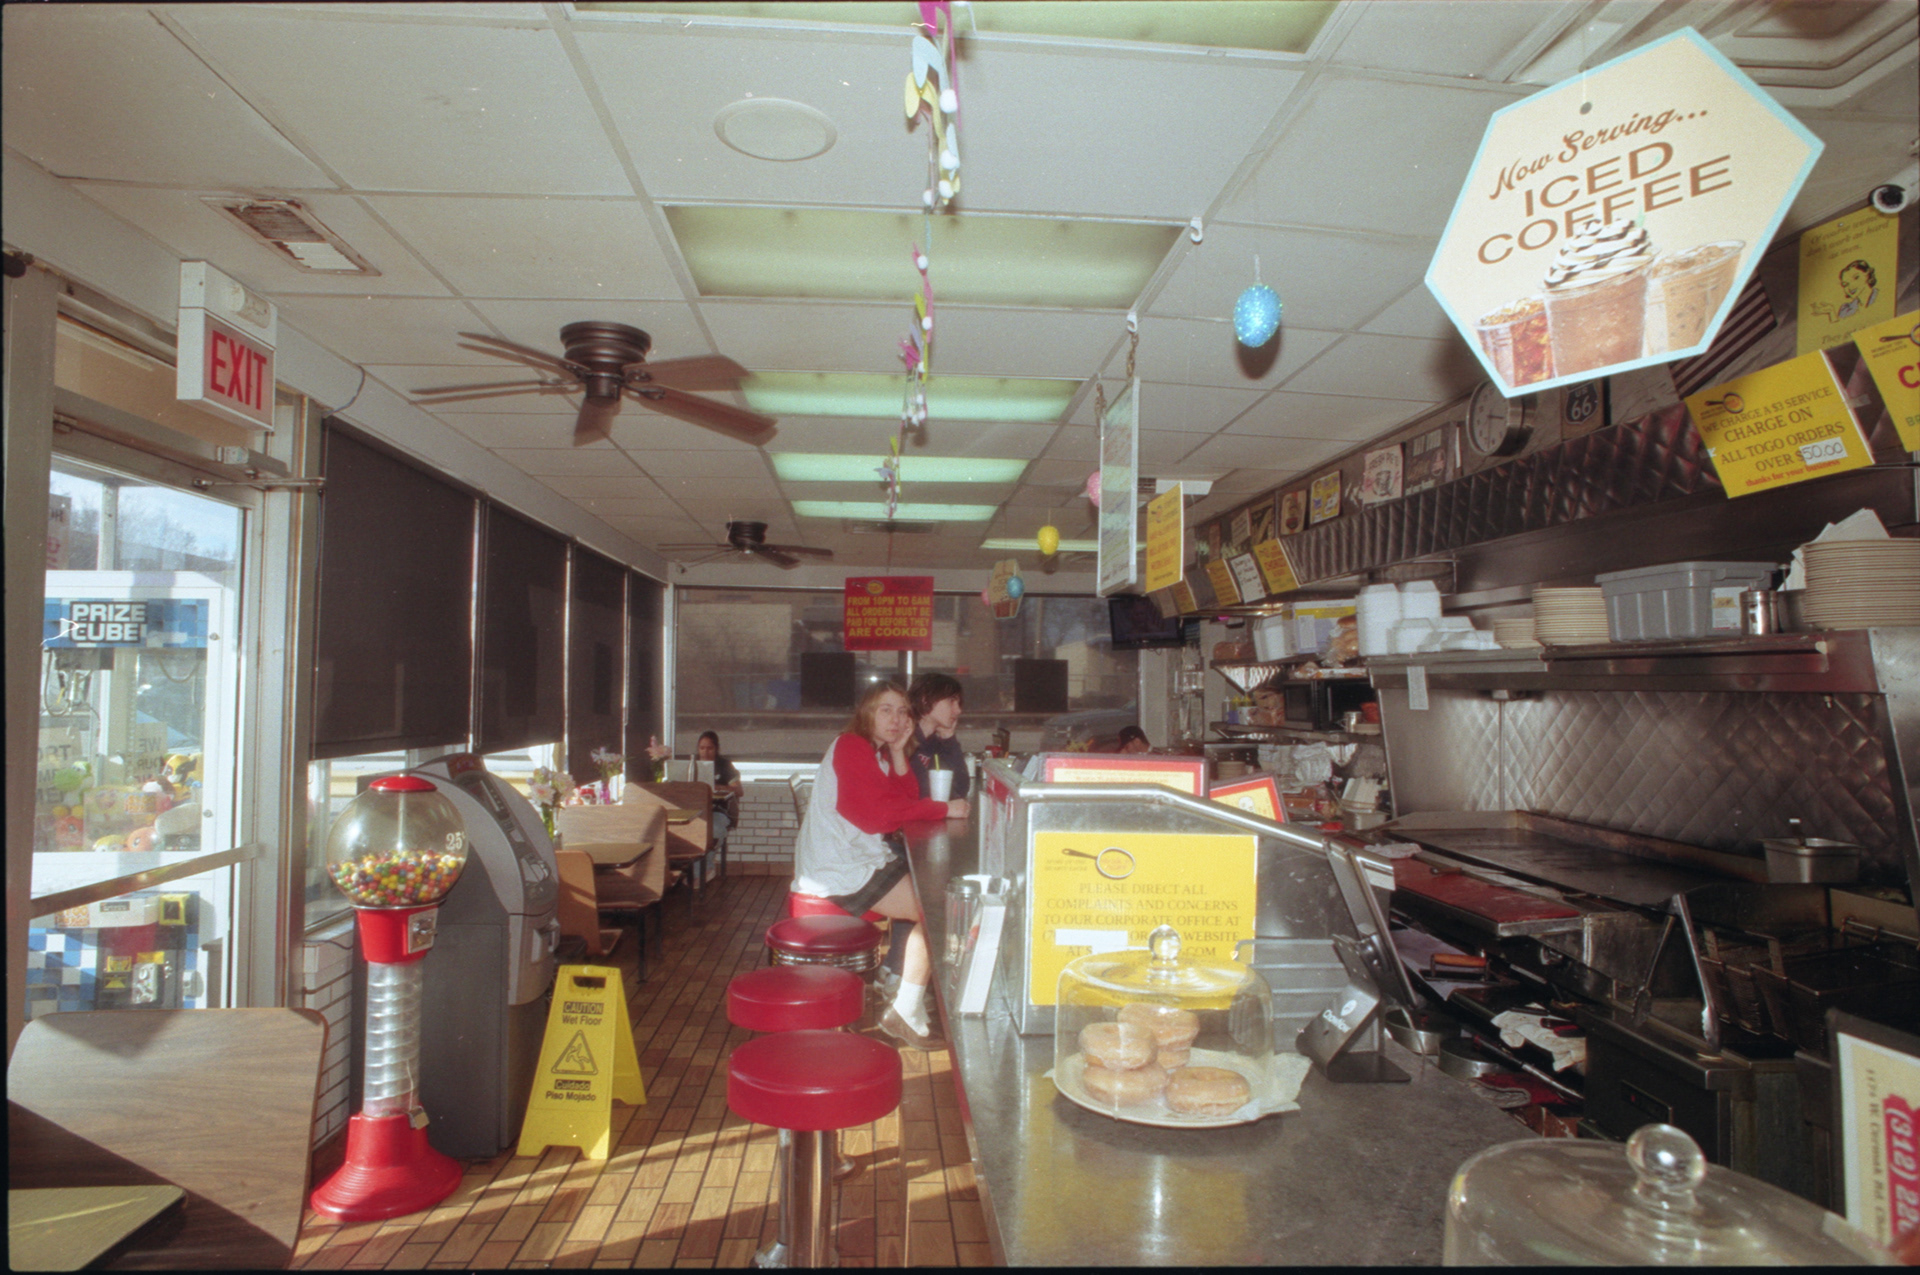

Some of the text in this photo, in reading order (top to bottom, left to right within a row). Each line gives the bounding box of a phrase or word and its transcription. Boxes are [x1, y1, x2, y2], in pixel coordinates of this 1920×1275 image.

[1489, 154, 1553, 200] Now
[1525, 141, 1674, 217] ICED
[1478, 155, 1733, 265] COFFEE
[210, 329, 268, 410] EXIT
[1898, 362, 1920, 388] C
[1571, 395, 1592, 420] 66
[1702, 421, 1719, 433] WE
[1720, 408, 1762, 428] CHARGE
[1763, 406, 1772, 416] A
[1772, 401, 1785, 413] $3
[1784, 387, 1833, 408] SERVICE
[1724, 406, 1814, 443] CHARGE ON
[1720, 421, 1846, 465] ALL TOGO ORDERS
[1755, 456, 1795, 472] OVER
[1745, 459, 1841, 487] thanks for your business
[848, 596, 870, 605] FROM
[897, 596, 909, 605] TO
[72, 603, 146, 622] PRIZE
[846, 607, 931, 616] ALL ORDERS MUST BE
[846, 617, 930, 626] PAID FOR BEFORE THEY
[71, 622, 139, 641] CUBE
[848, 627, 928, 637] ARE COOKED
[1080, 883, 1207, 895] PLEASE DIRECT ALL
[1047, 899, 1238, 910] COMPLAINTS AND CONCERNS
[1044, 914, 1241, 926] TO OUR CORPORATE OFFICE AT
[1130, 930, 1148, 941] OR
[1183, 931, 1240, 942] WEBSITE
[1067, 946, 1081, 956] AT
[564, 1002, 603, 1014] CAUTION
[562, 1015, 602, 1026] Wet Floor
[555, 1080, 591, 1091] Cuidado
[546, 1091, 596, 1103] Piso Mojado
[1885, 1108, 1917, 1181] (312)
